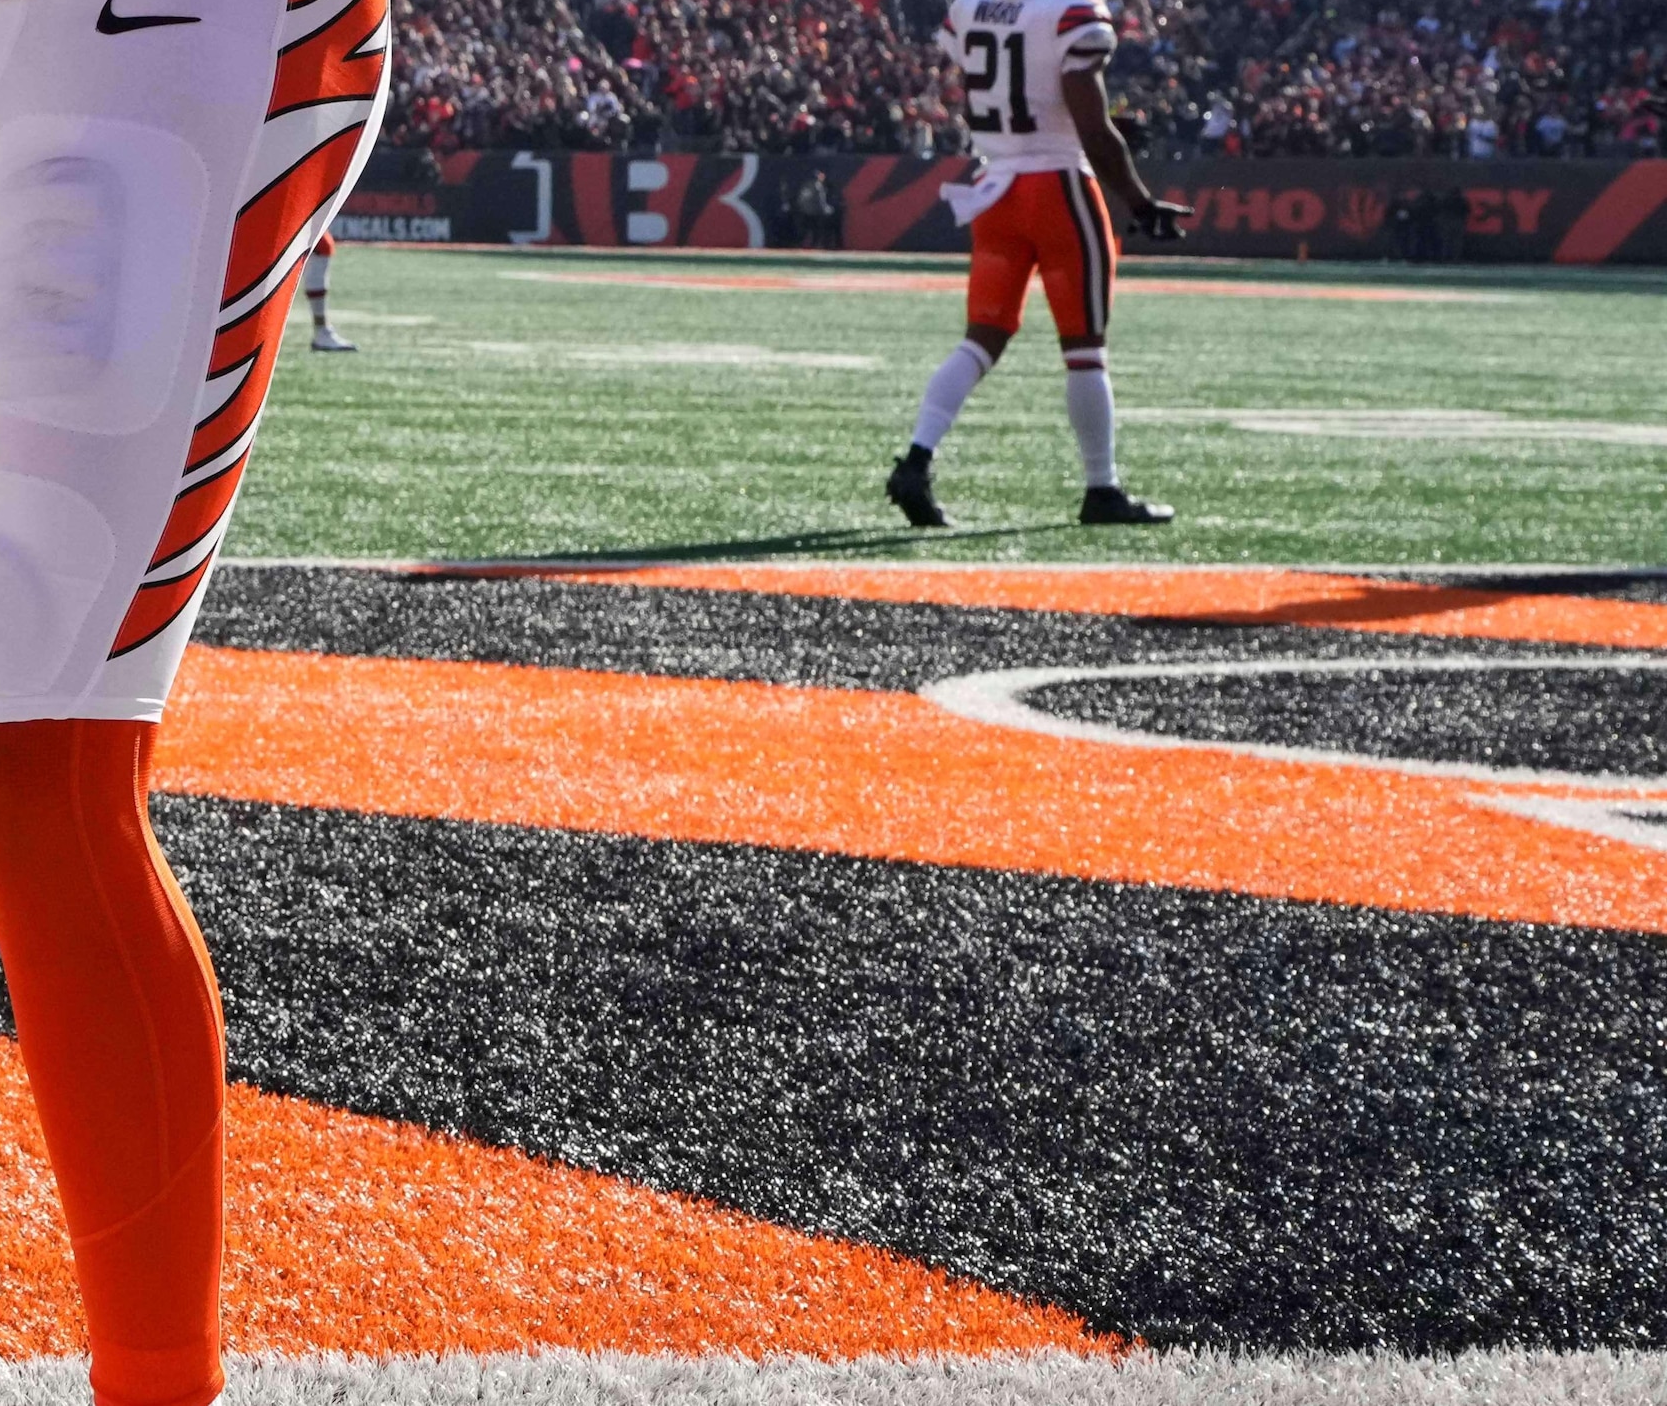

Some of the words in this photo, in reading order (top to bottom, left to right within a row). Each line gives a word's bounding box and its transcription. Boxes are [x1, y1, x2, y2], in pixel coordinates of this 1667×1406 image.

[973, 0, 1025, 26] WARD
[964, 30, 1038, 134] 21
[1167, 185, 1326, 233] WHO
